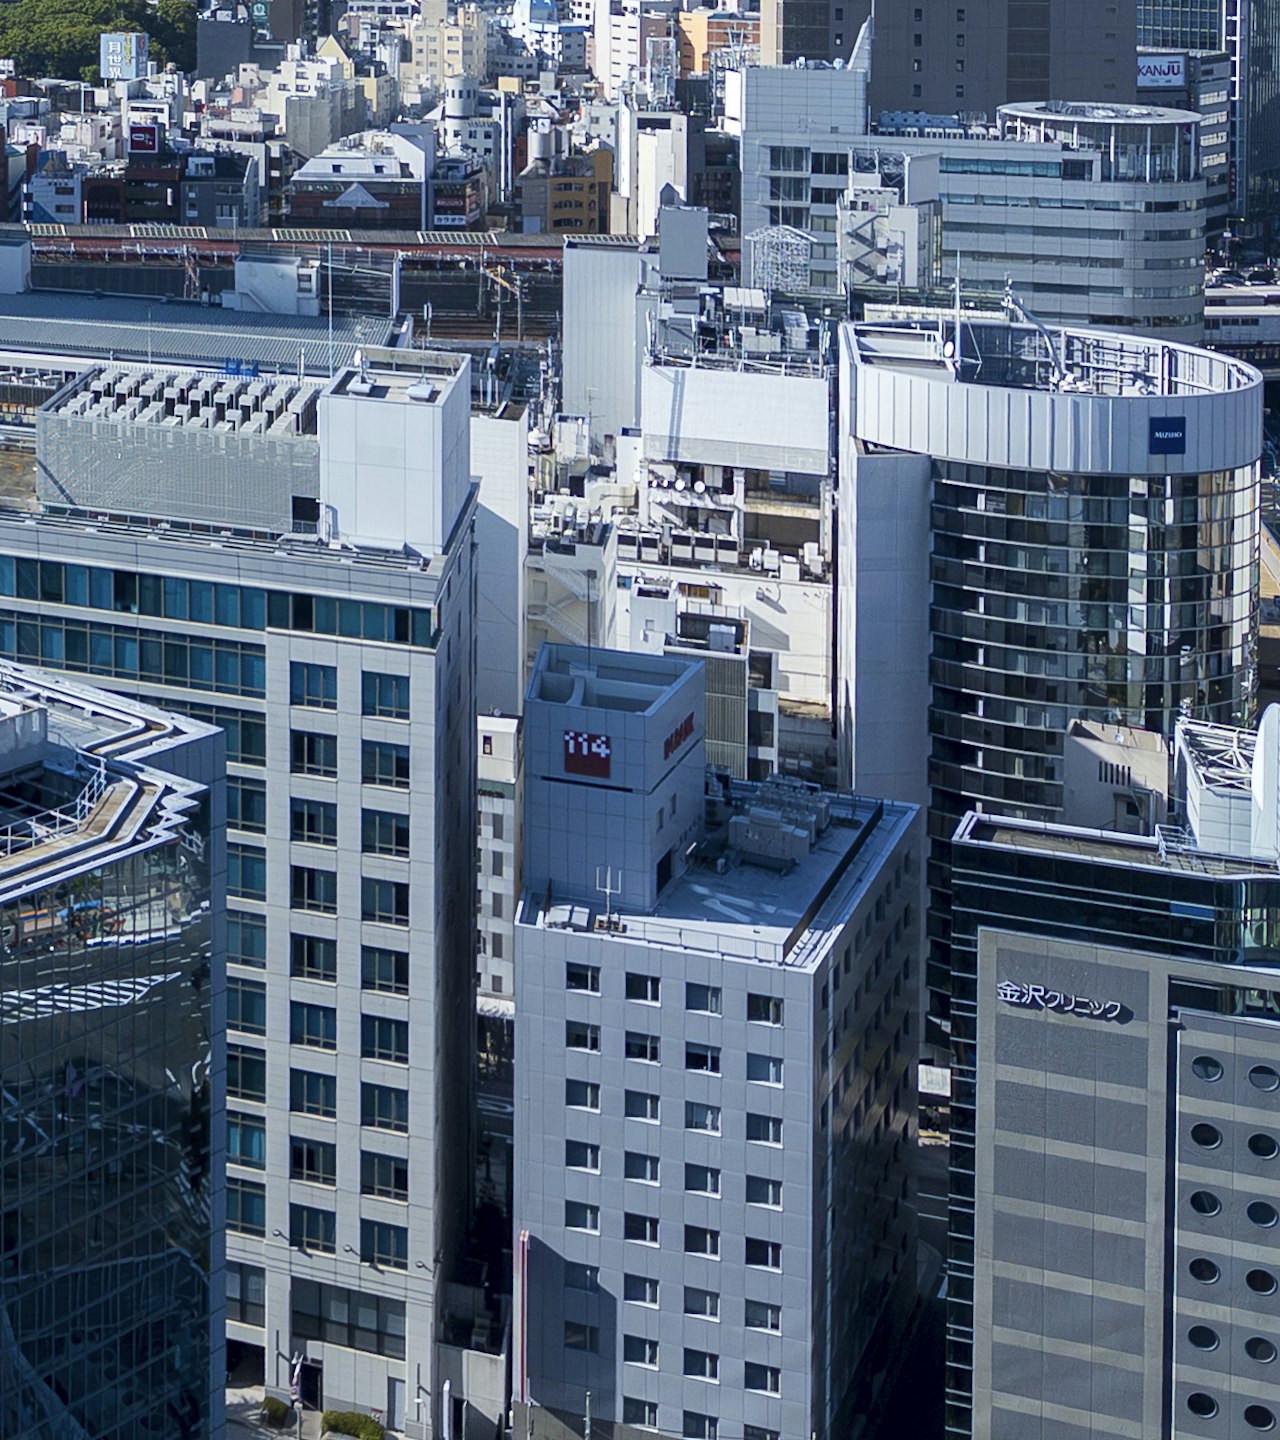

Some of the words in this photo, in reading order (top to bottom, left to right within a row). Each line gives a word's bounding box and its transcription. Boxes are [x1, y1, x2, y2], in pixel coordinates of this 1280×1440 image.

[564, 731, 610, 758] 114
[997, 980, 1121, 1018] 金沢クリニック
